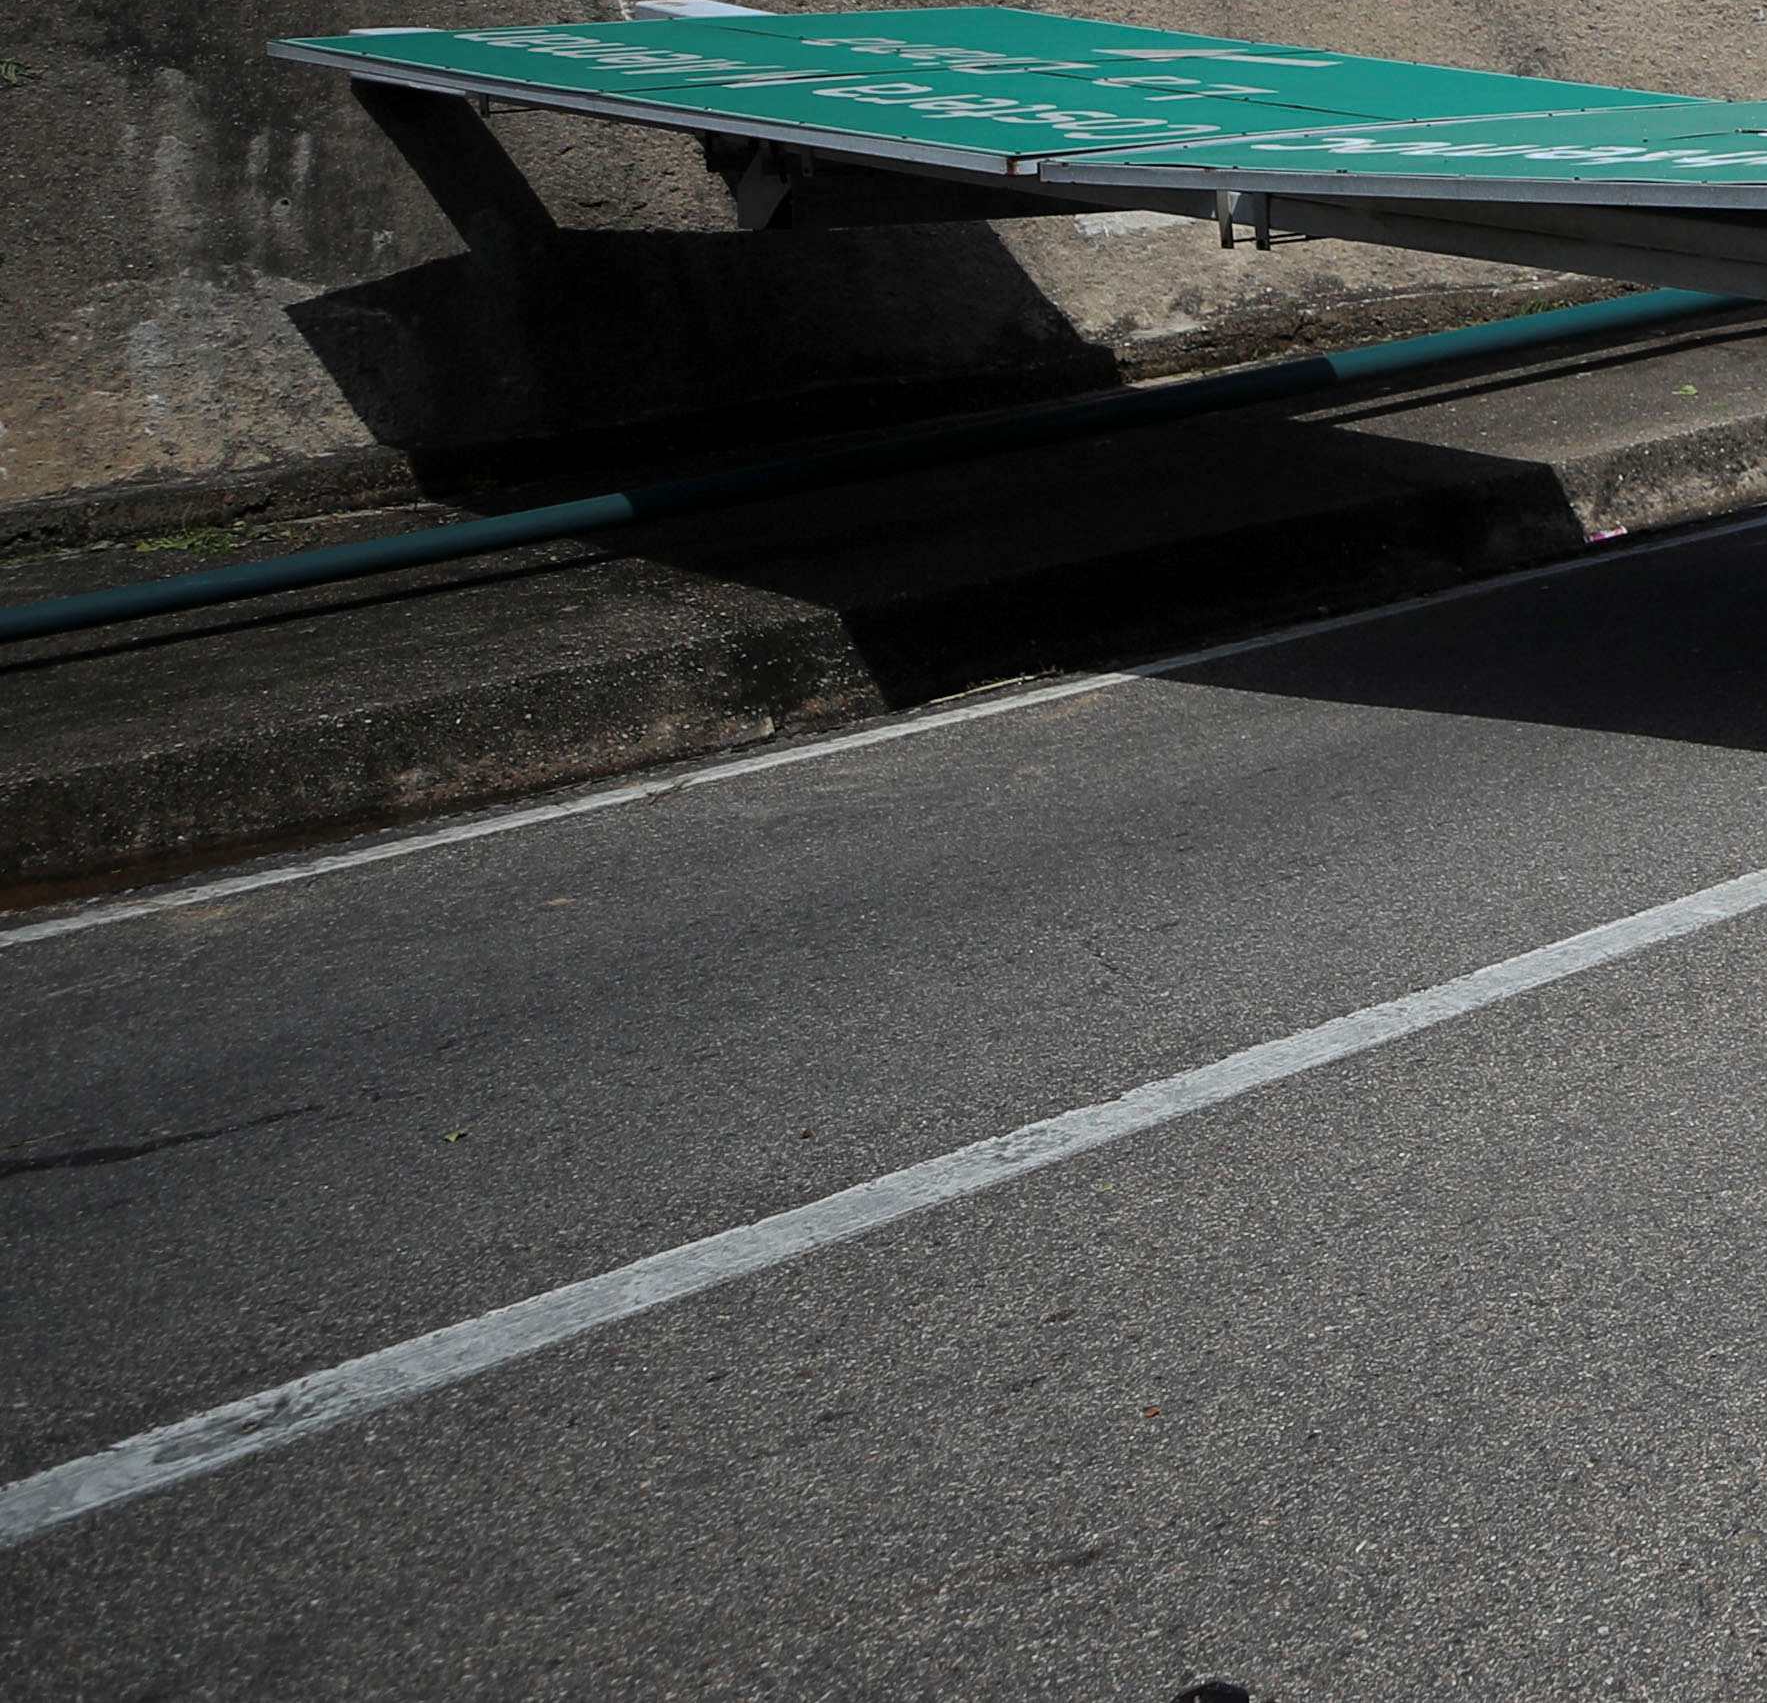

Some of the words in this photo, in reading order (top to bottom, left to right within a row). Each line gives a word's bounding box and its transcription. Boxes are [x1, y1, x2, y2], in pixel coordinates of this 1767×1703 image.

[452, 28, 785, 77] Aleman
[802, 36, 1099, 75] Diana
[809, 82, 1221, 139] Costera
[1091, 75, 1278, 102] La
